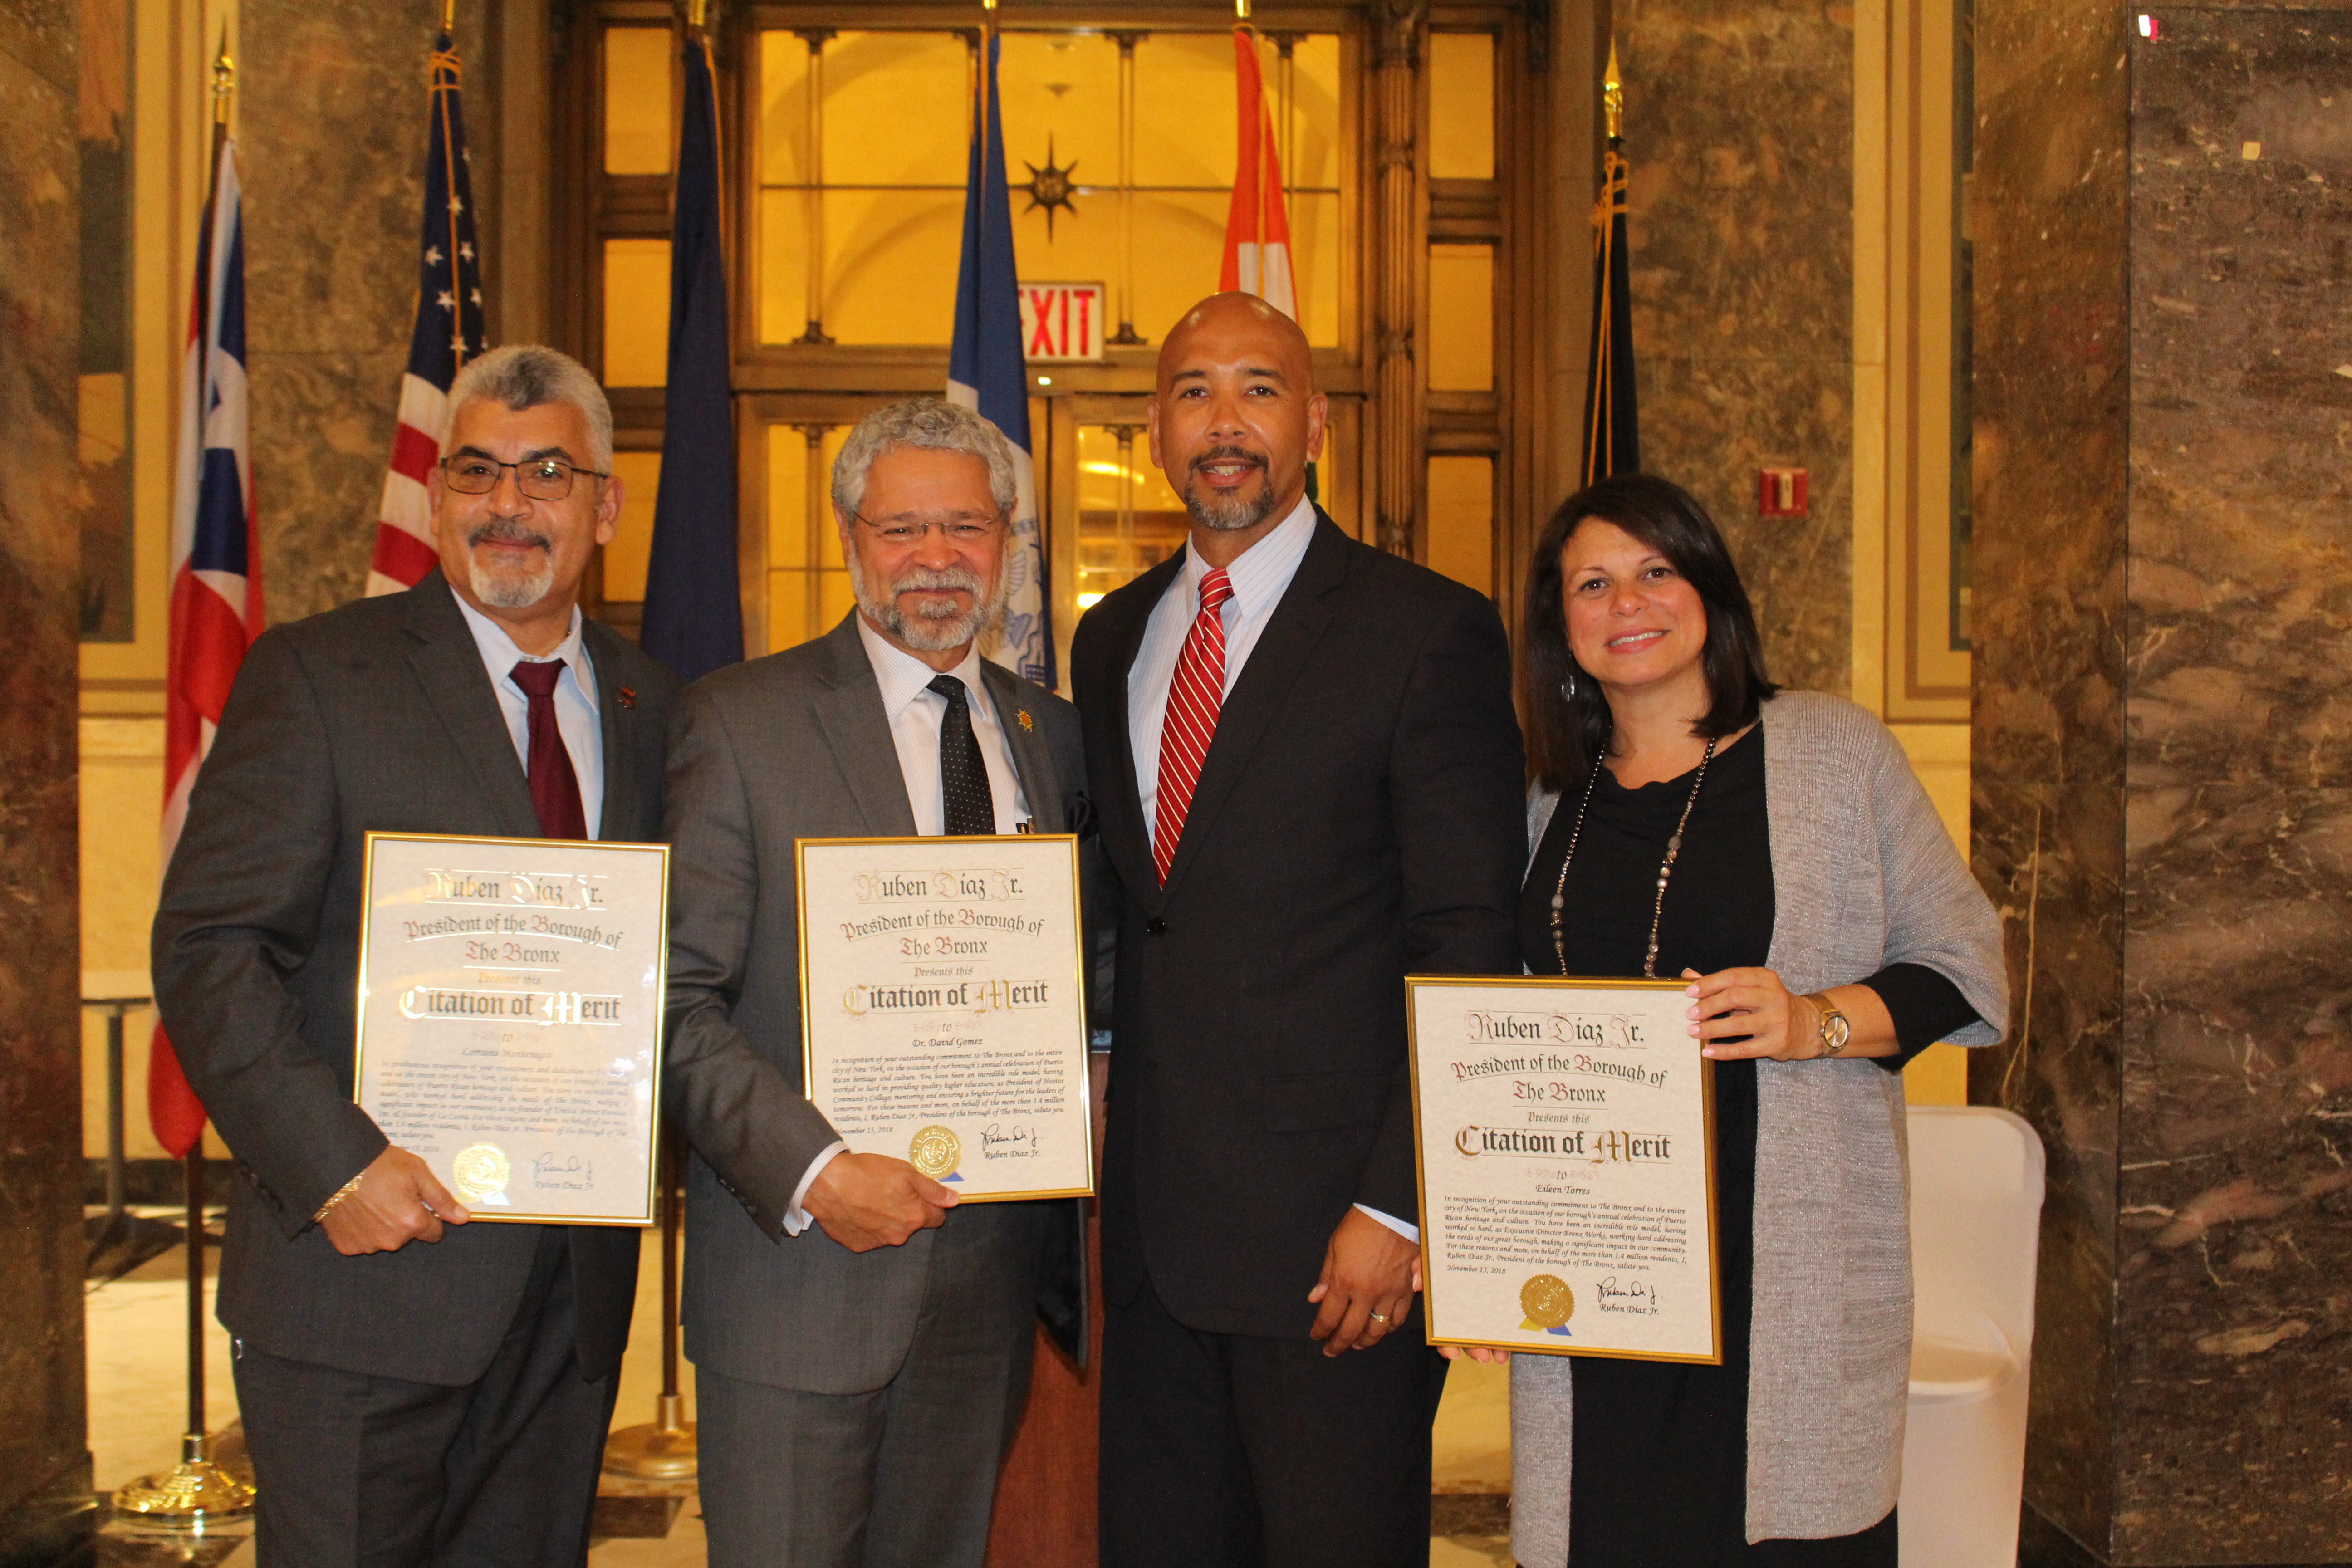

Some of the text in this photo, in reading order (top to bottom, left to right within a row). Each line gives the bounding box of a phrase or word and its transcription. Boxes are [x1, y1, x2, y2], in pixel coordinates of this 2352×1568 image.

[426, 872, 603, 910] Ruben Diaz Jr.
[856, 871, 1024, 901] Ruben Diaz Jr.
[403, 914, 623, 950] President of the Borough of
[840, 908, 1044, 941] President of the Borough of
[466, 941, 560, 963] The Bronx
[900, 936, 988, 960] The Bronx
[914, 965, 973, 978] Presents this
[399, 985, 622, 1026] Citation of Merit
[843, 980, 1048, 1015] Citation of Merit
[941, 1021, 952, 1032] to
[1465, 1010, 1645, 1049] Ruben Diaz Jr.
[502, 1033, 513, 1043] to
[913, 1037, 983, 1049] Dr. David Gomez
[841, 1057, 874, 1065] recognition
[875, 1055, 882, 1064] of
[898, 1054, 935, 1063] outstanding
[1451, 1054, 1668, 1089] President of the Borough of
[1512, 1080, 1606, 1103] The Bronx
[1527, 1111, 1590, 1124] Presents this
[878, 1125, 893, 1133] 2018
[985, 1149, 1040, 1160] Ruben Diaz Jr.
[1455, 1125, 1671, 1164] Citation of Merit
[1557, 1170, 1567, 1180] to
[1536, 1184, 1591, 1195] Eileen Torres
[1488, 1197, 1495, 1205] of
[1512, 1199, 1549, 1208] outstanding
[1612, 1204, 1632, 1212] Bronx
[1456, 1205, 1463, 1213] of
[1481, 1206, 1498, 1215] York,
[1546, 1210, 1553, 1218] of
[1566, 1210, 1596, 1221] borough's
[1621, 1214, 1655, 1222] celebration
[1656, 1216, 1663, 1225] of
[1465, 1214, 1490, 1224] heritage
[1641, 1225, 1661, 1233] model,
[1664, 1226, 1686, 1235] having
[1475, 1234, 1482, 1243] of
[1512, 1236, 1539, 1246] borough,
[1541, 1238, 1564, 1248] making
[1571, 1239, 1604, 1249] significant
[1650, 1246, 1686, 1254] community.
[1477, 1225, 1493, 1233] hard,
[1503, 1226, 1534, 1235] Executive
[1584, 1231, 1607, 1239] Works,
[1609, 1233, 1636, 1242] working
[1653, 1234, 1686, 1245] addressing
[1599, 1303, 1659, 1316] Ruben Diaz Jr.
